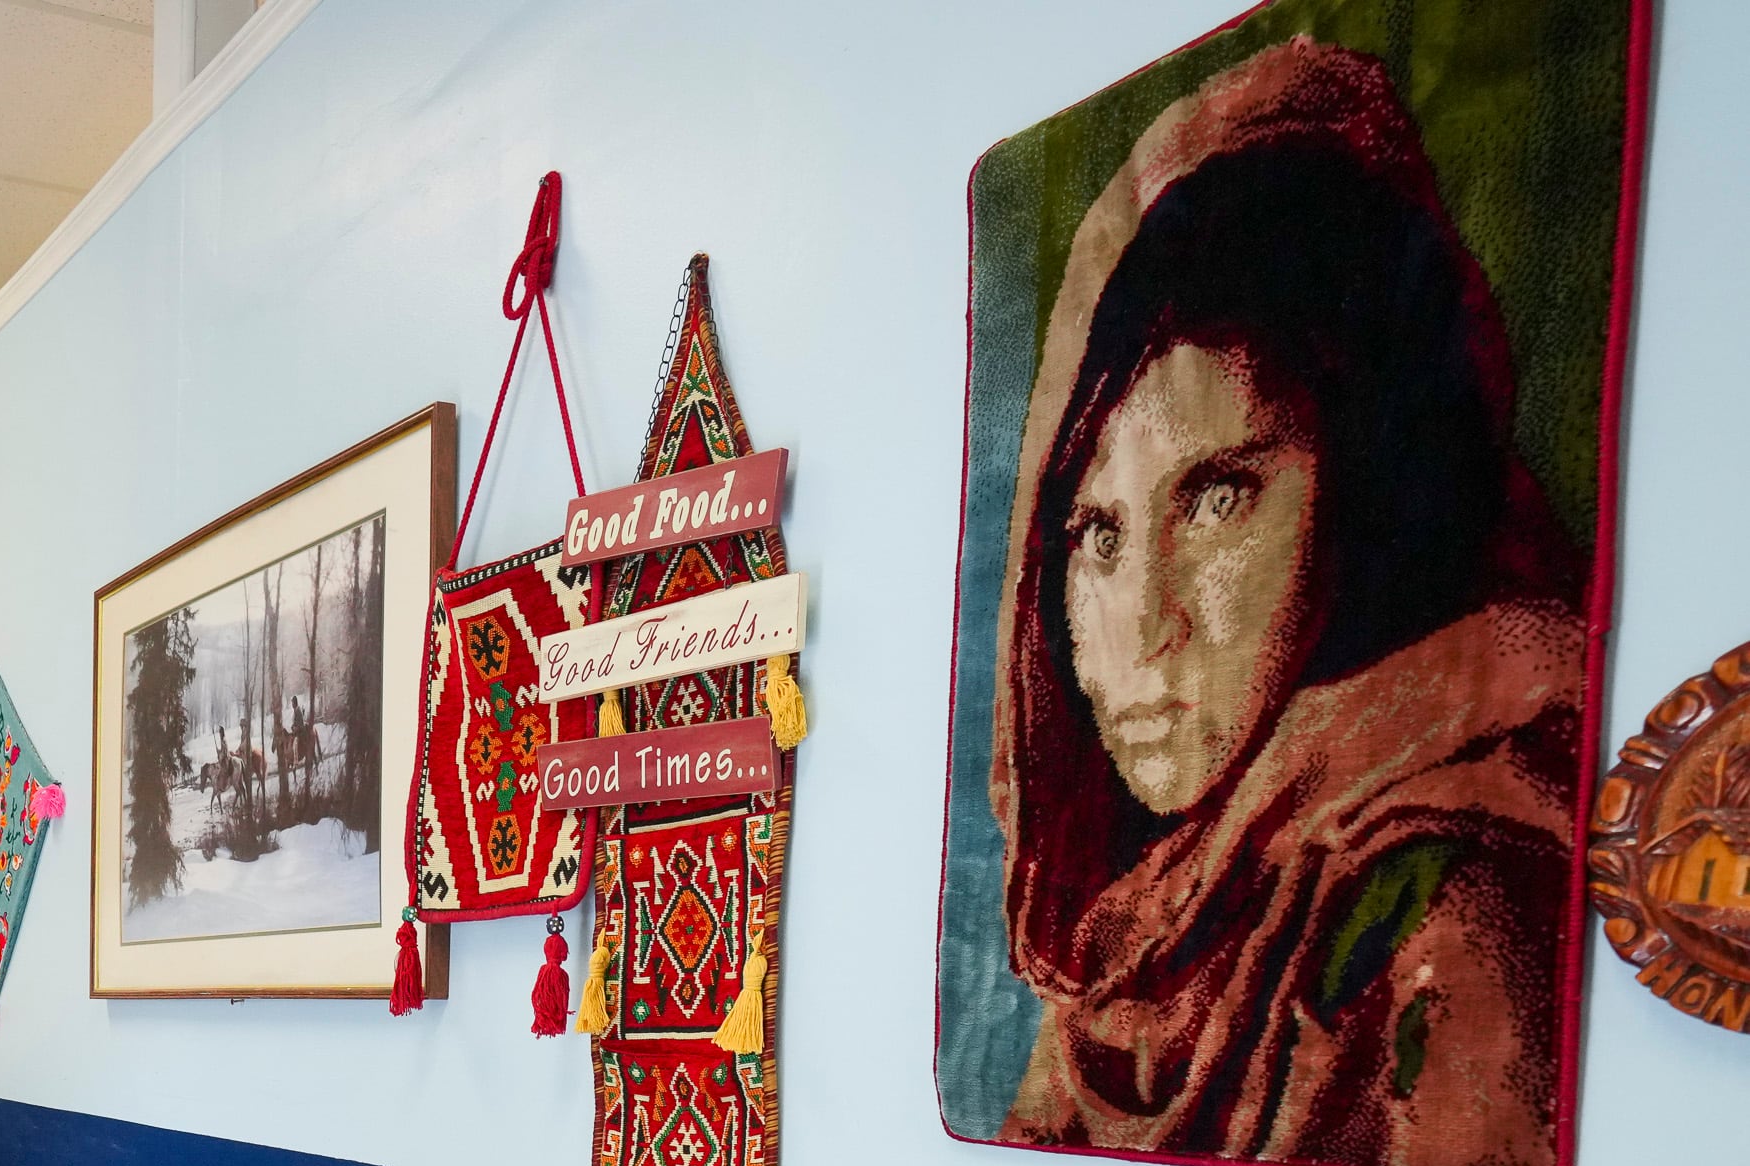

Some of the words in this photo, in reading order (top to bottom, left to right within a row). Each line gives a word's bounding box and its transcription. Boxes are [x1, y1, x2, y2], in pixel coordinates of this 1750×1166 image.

[566, 494, 645, 557] Good
[649, 469, 768, 540] Food...
[543, 632, 622, 692] Good
[629, 599, 794, 670] Friends...
[543, 750, 621, 800] Good
[635, 746, 768, 789] Times...
